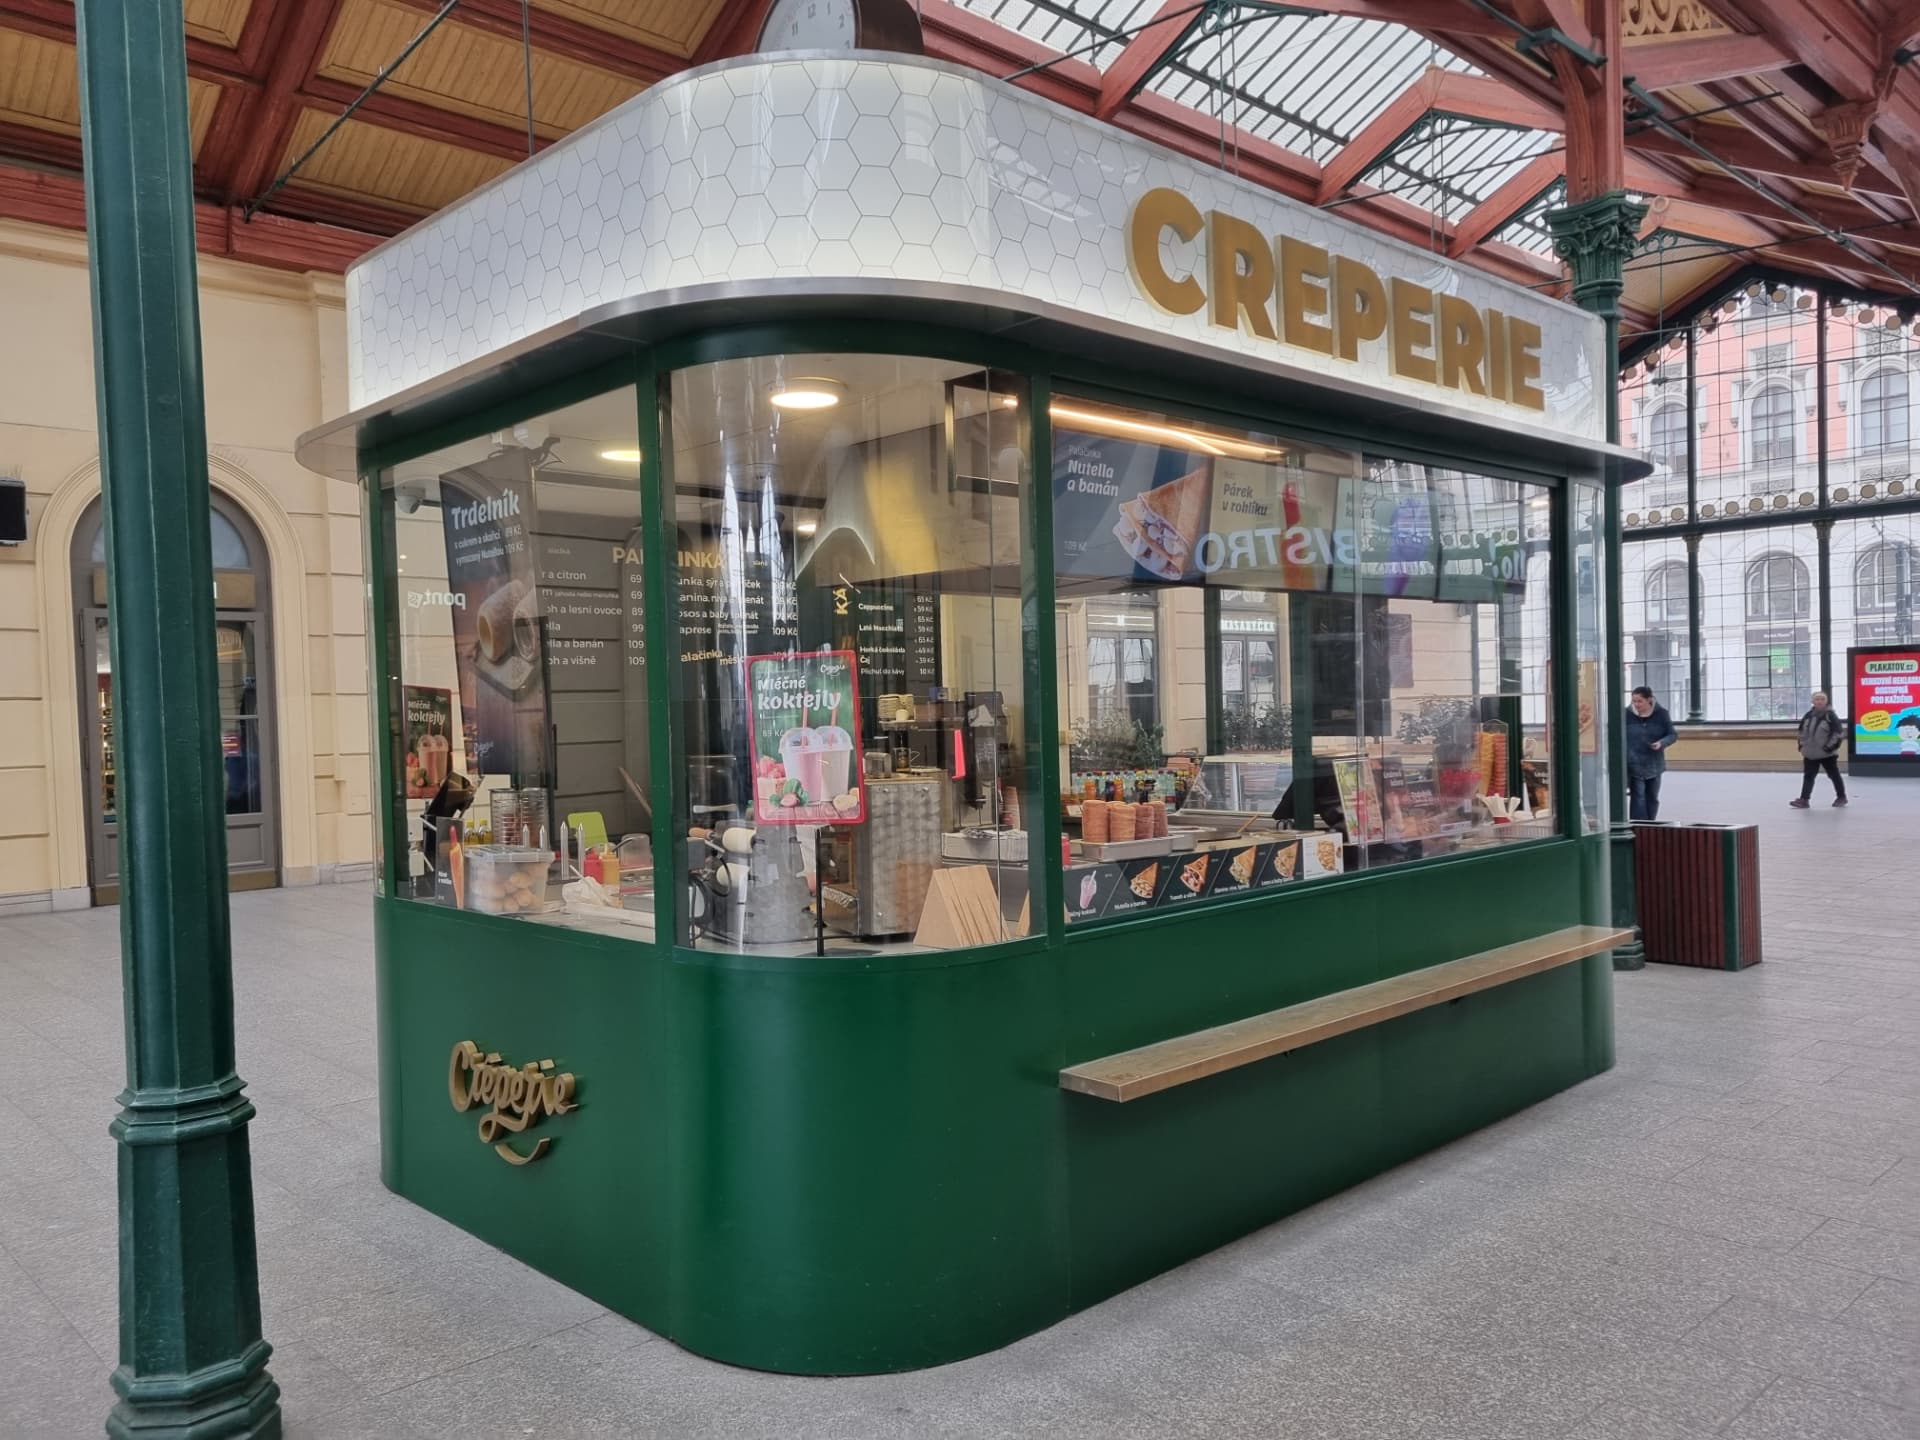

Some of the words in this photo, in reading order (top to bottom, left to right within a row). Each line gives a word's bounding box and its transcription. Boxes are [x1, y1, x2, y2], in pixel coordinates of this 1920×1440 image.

[1124, 186, 1545, 412] CREPERIE
[1068, 459, 1114, 479] Nutella
[1067, 479, 1075, 491] a
[1078, 478, 1119, 497] banán
[1223, 483, 1253, 499] Párek
[451, 488, 520, 530] Trdelník
[1230, 500, 1268, 516] rohlíku
[556, 571, 587, 581] citron
[630, 574, 642, 583] 69
[631, 591, 643, 600] 69
[560, 607, 567, 615] a
[569, 604, 592, 615] lesní
[593, 607, 623, 616] ovoce
[631, 608, 644, 617] 89
[631, 624, 645, 633] 99
[680, 626, 712, 635] aprese
[572, 638, 604, 650] banán
[627, 640, 645, 649] 109
[570, 655, 597, 665] višně
[628, 656, 645, 665] 109
[680, 650, 723, 663] alačinka
[757, 676, 806, 690] Mléčné
[757, 690, 841, 711] koktejly
[408, 710, 446, 725] koktejly
